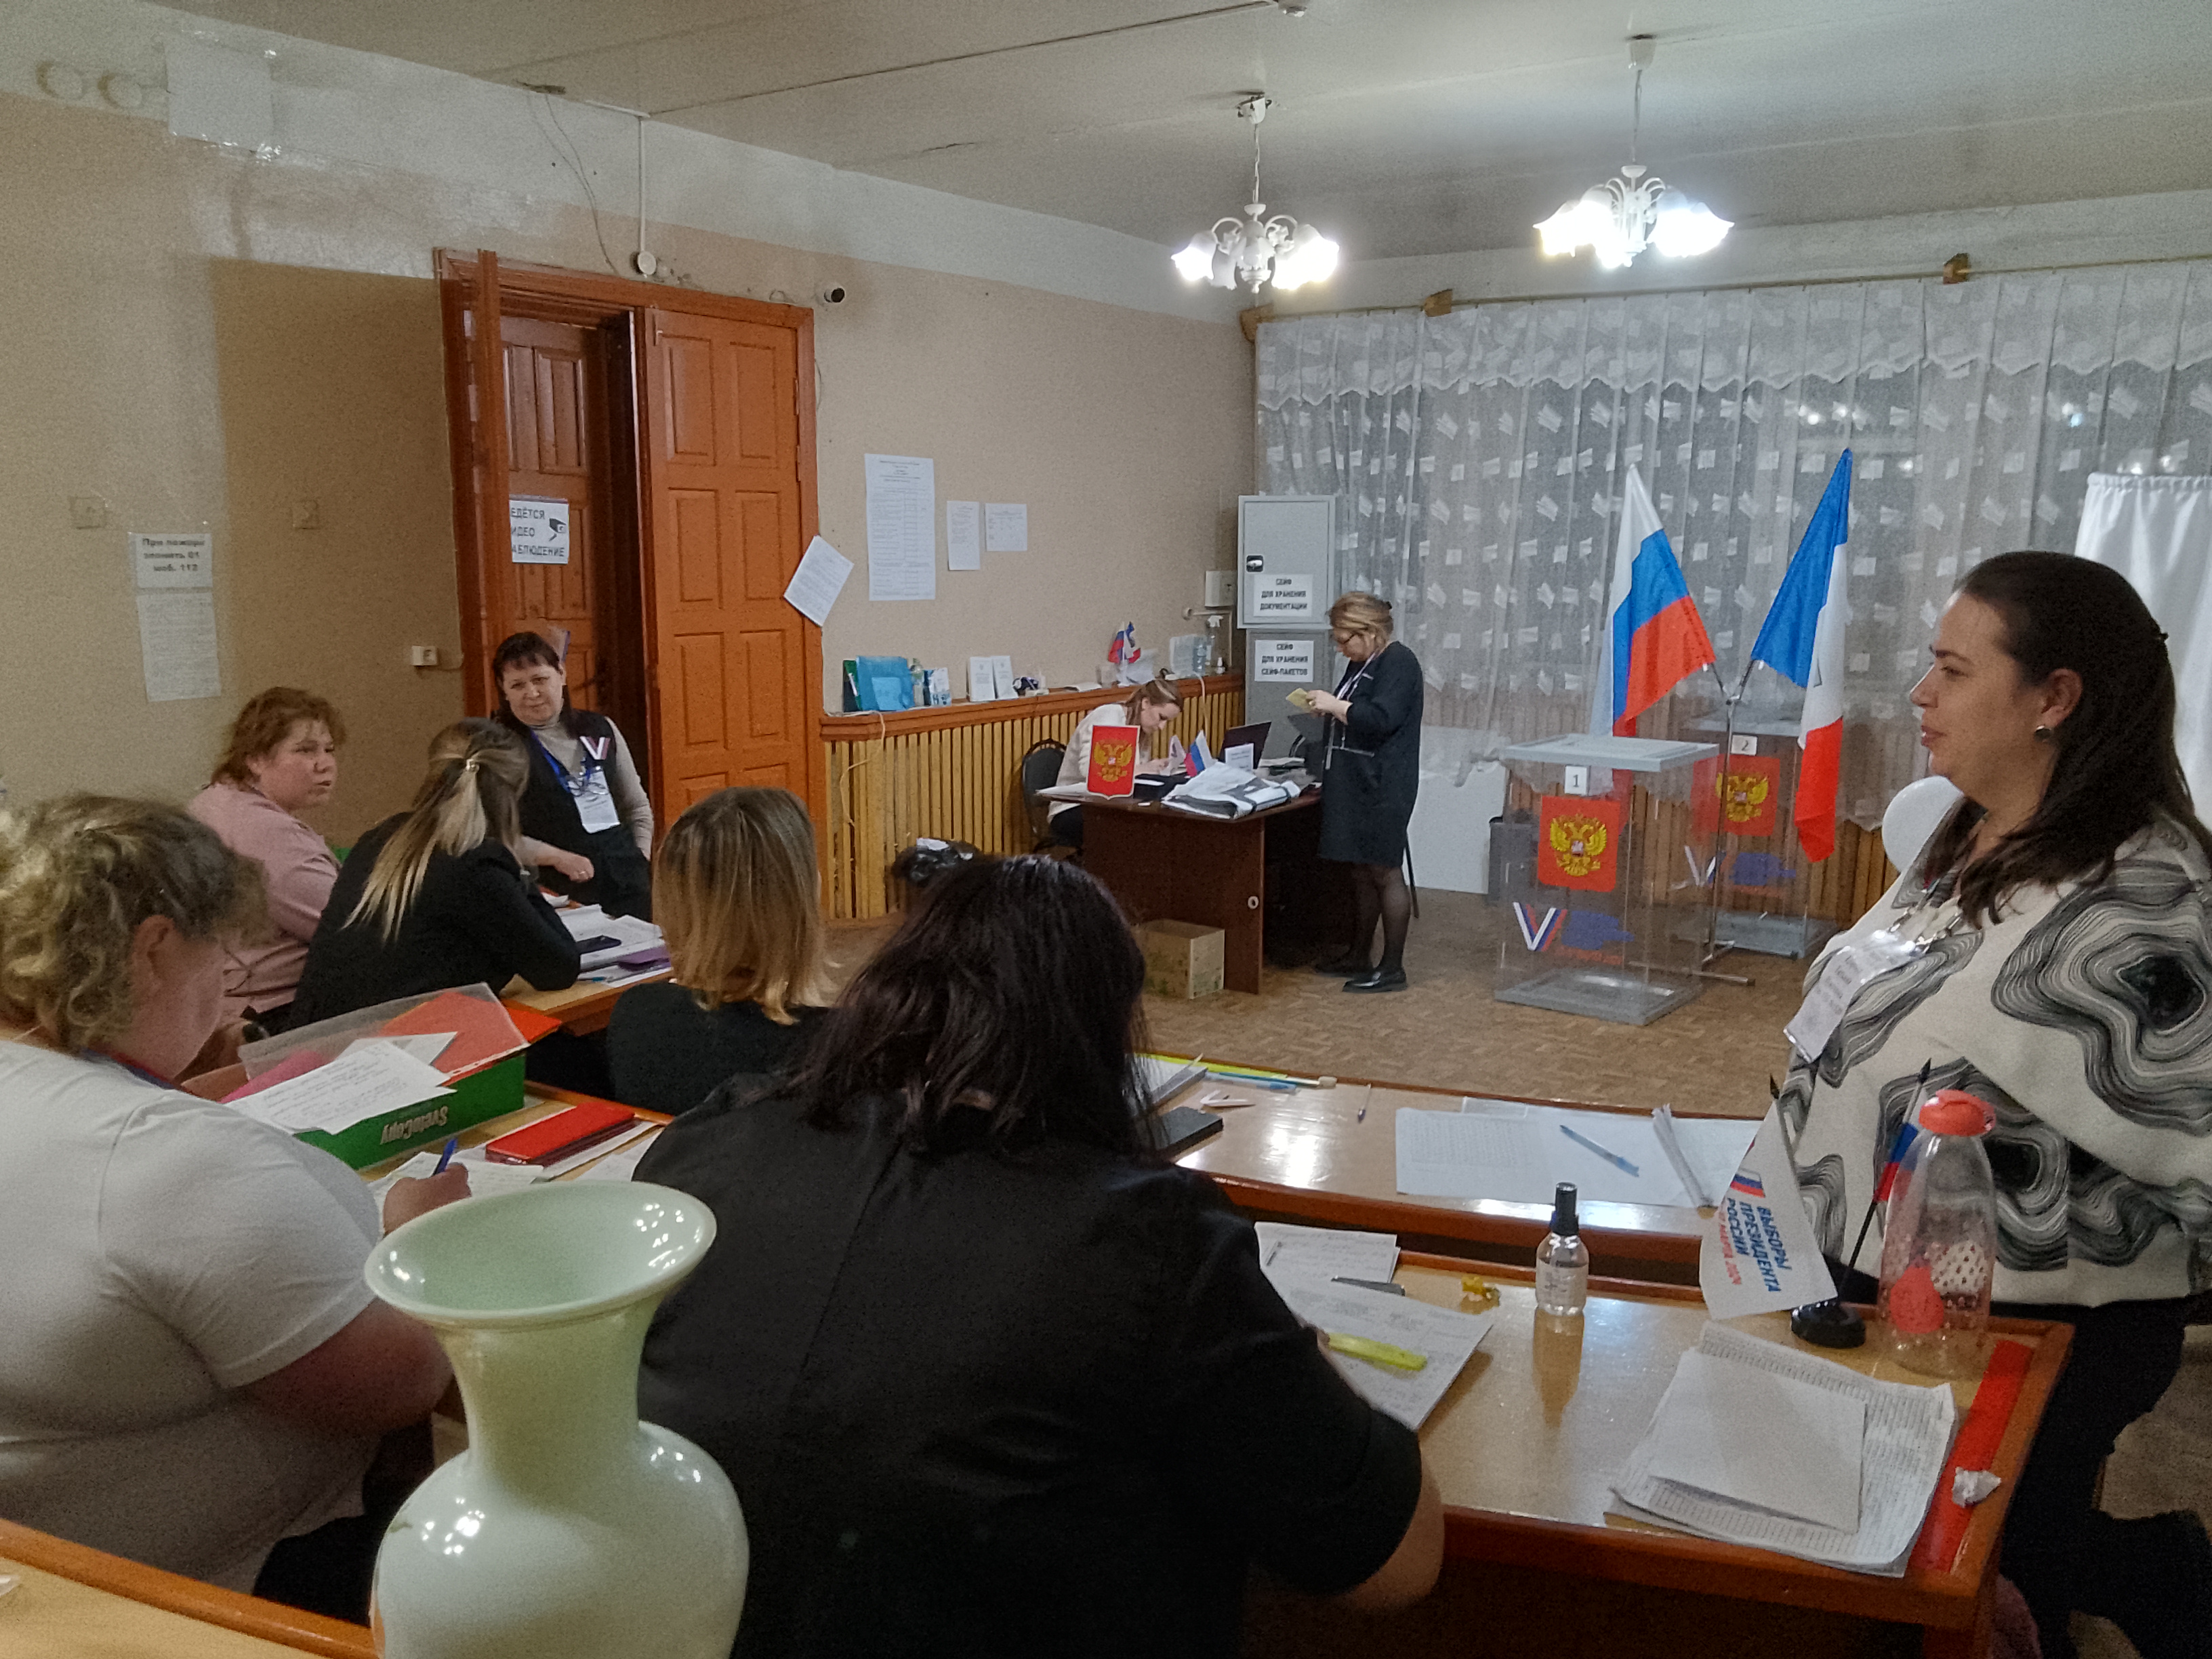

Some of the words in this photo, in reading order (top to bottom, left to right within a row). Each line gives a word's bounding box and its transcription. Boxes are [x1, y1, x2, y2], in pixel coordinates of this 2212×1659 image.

[510, 507, 546, 519] ЕДЁТСЯ
[512, 525, 535, 537] ИДЕО
[512, 544, 565, 556] АБЛЮДЕНИЕ
[1261, 590, 1274, 598] ДЛЯ
[1260, 602, 1308, 611] ДОКУМЕНТАЦИИ
[1276, 642, 1294, 651] СЕЙФ
[1261, 655, 1274, 663] ДЛЯ
[1275, 655, 1309, 663] ХРАНЕНИЯ
[1261, 668, 1309, 676] СЕЙФ-ПАКЕТОВ
[1741, 737, 1749, 752] 2
[1572, 773, 1580, 788] 1
[380, 1105, 449, 1145] SvetoCopy
[1727, 1197, 1750, 1256] РОССИИ
[1757, 1206, 1793, 1271] ВЫБОРЫ
[1739, 1201, 1782, 1292] ПРЕЗИДЕНТА
